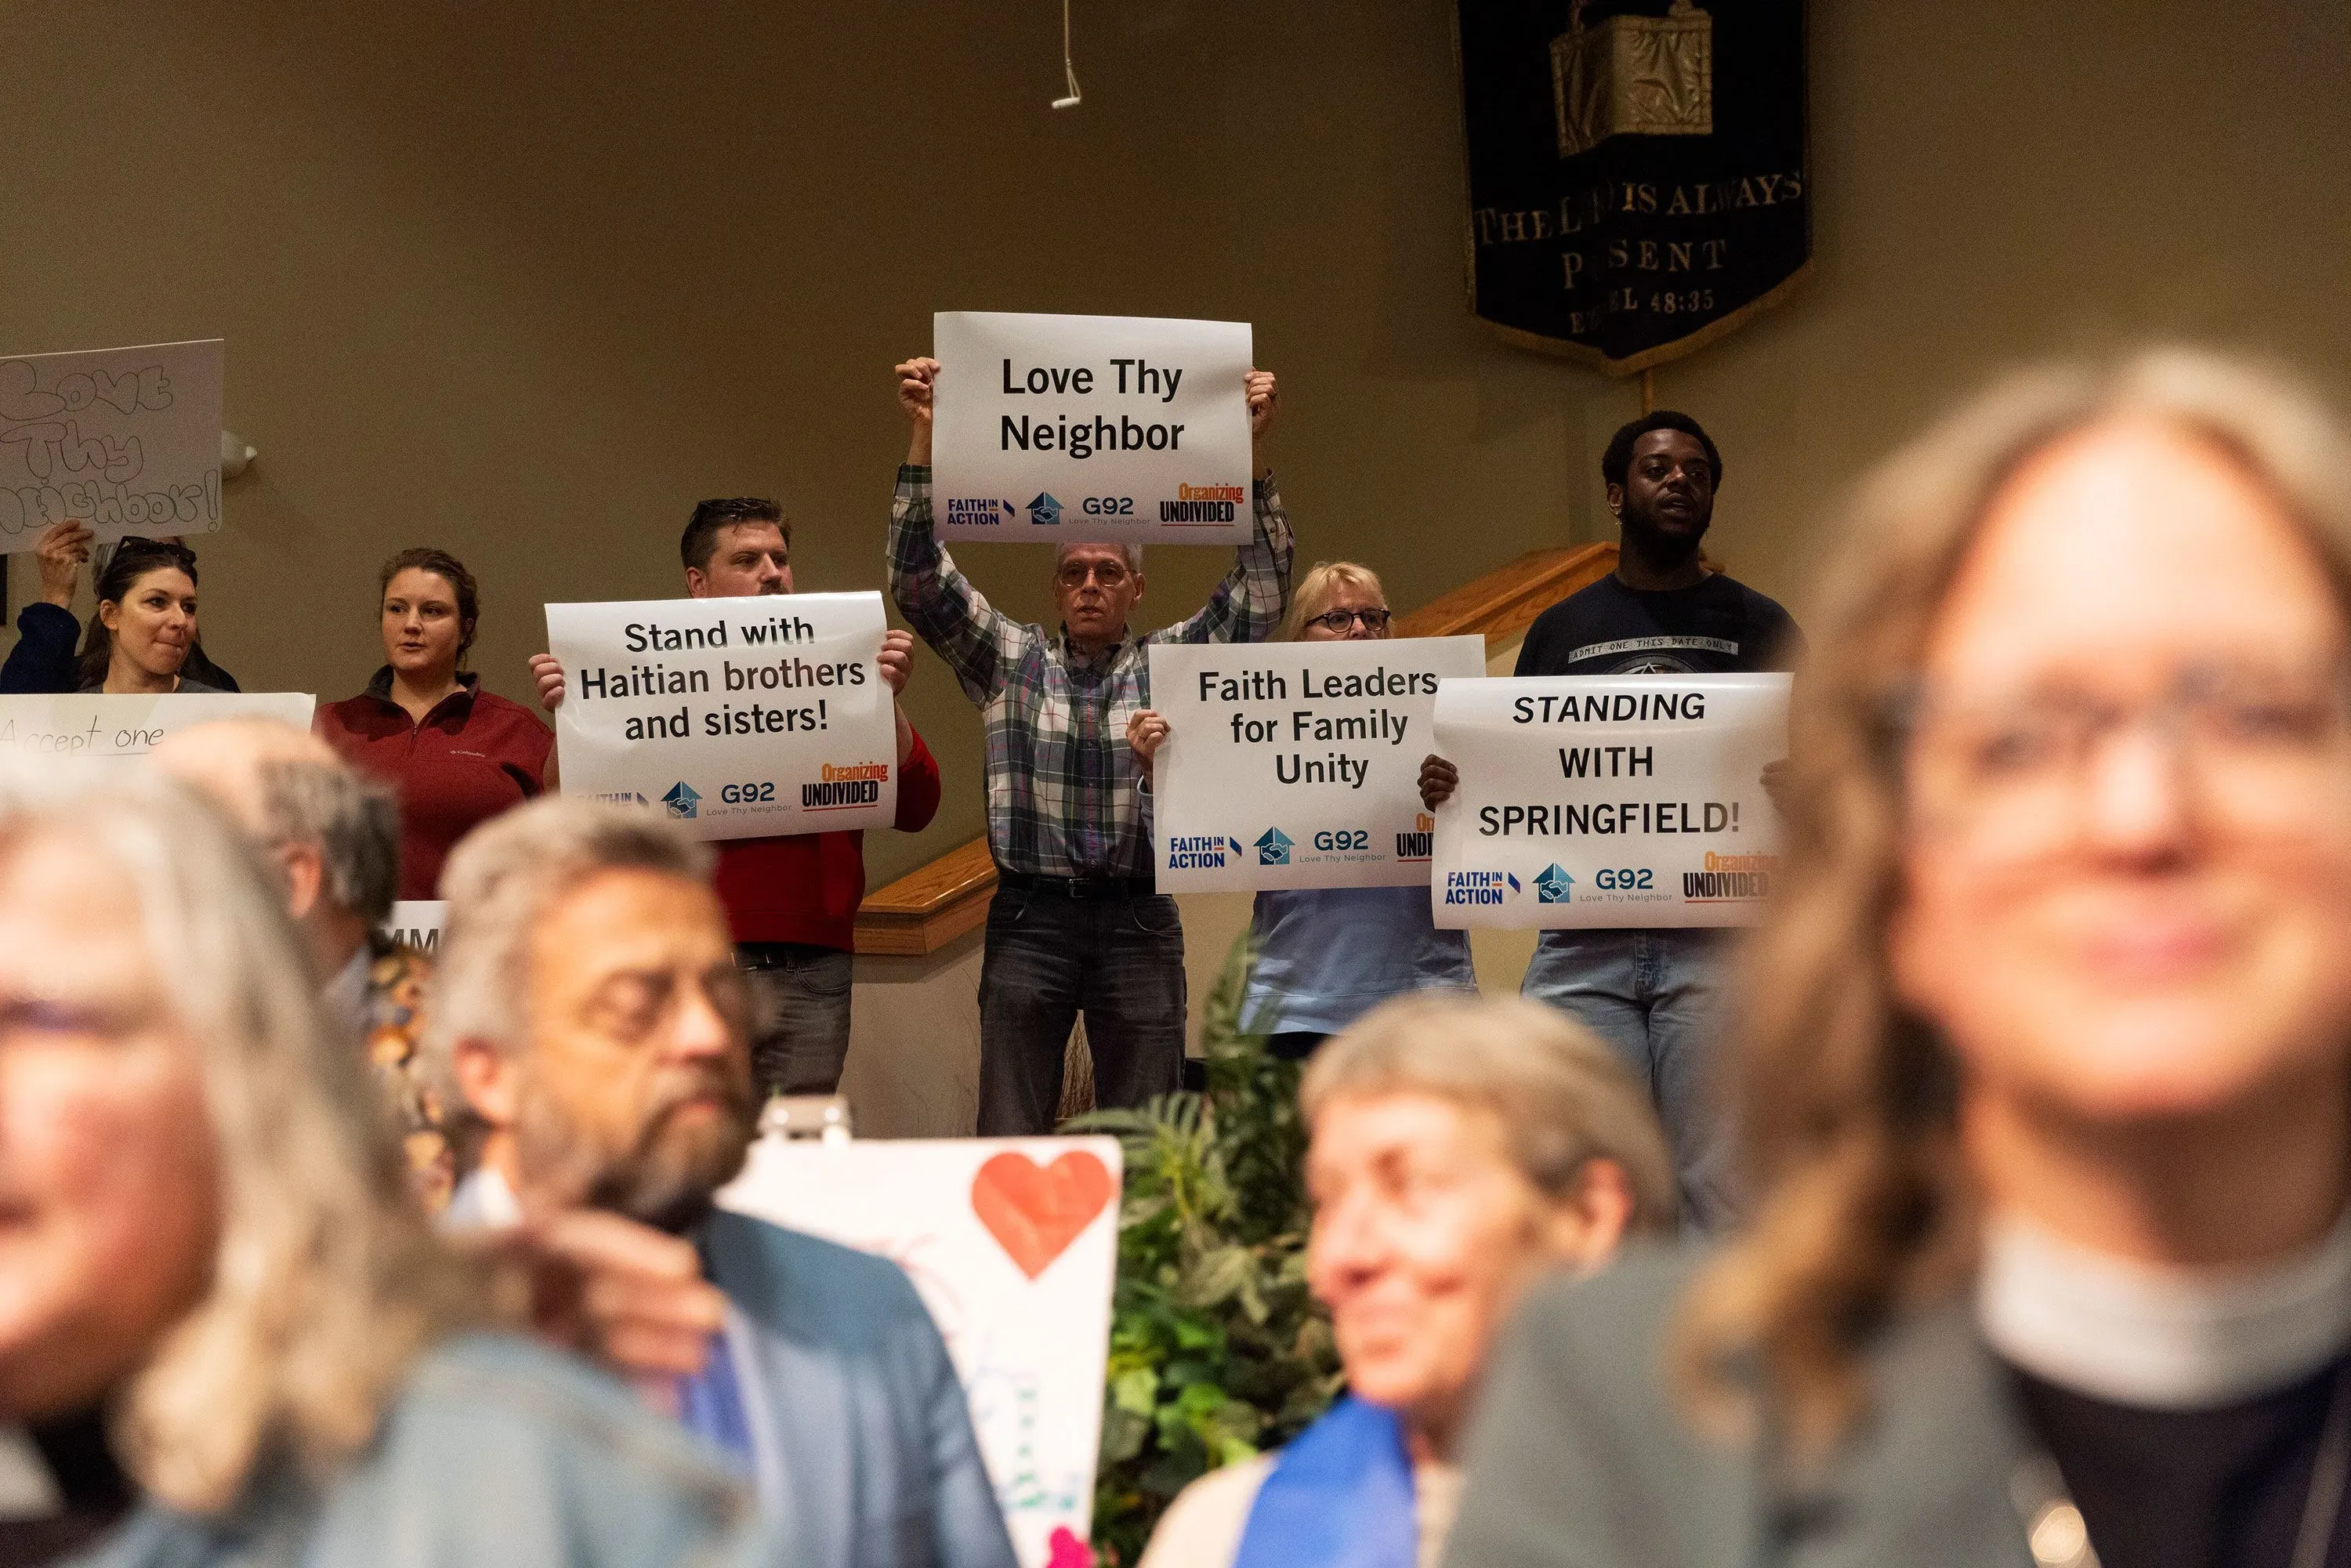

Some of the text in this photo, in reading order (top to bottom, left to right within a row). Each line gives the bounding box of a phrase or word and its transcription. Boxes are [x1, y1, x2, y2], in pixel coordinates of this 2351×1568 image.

[1473, 207, 1553, 246] THE
[1621, 182, 1657, 215] IS
[1650, 288, 1715, 314] 48:35
[1003, 359, 1183, 402] Love Thy
[1002, 415, 1184, 459] Neighbor
[1179, 482, 1244, 504] Organizing
[948, 498, 998, 512] FAITH IN
[1082, 497, 1134, 515] G92
[1160, 502, 1234, 523] UNDIVIDED
[947, 513, 999, 525] ACTION
[625, 617, 814, 652] Stand with
[1573, 638, 1733, 659] ADMIT ONE THIS DATE ONLY
[581, 657, 865, 699] Haitian brothers
[1199, 667, 1438, 702] Faith Leaders
[1513, 693, 1705, 723] STANDING
[625, 699, 828, 741] and sisters!
[1230, 708, 1408, 745] for Family
[115, 729, 164, 748] one
[822, 762, 888, 783] Organizing
[1276, 752, 1369, 789] Unity
[1559, 746, 1653, 778] WITH
[721, 781, 775, 803] G92
[802, 780, 878, 807] UNDIVIDED
[732, 806, 748, 817] Thy
[750, 804, 792, 814] Neighbor
[1479, 802, 1740, 836] SPRINGFIELD!
[1170, 836, 1224, 852] FAITH IN
[1313, 831, 1369, 851] G92
[1168, 853, 1225, 869] ACTION
[1324, 854, 1341, 864] Thy
[1344, 853, 1386, 862] Neighbor
[1447, 871, 1502, 887] FAITH IN
[1595, 868, 1654, 889] G92
[1445, 889, 1502, 904] ACTION
[1605, 893, 1625, 903] Thy
[1627, 893, 1672, 902] Neighbor
